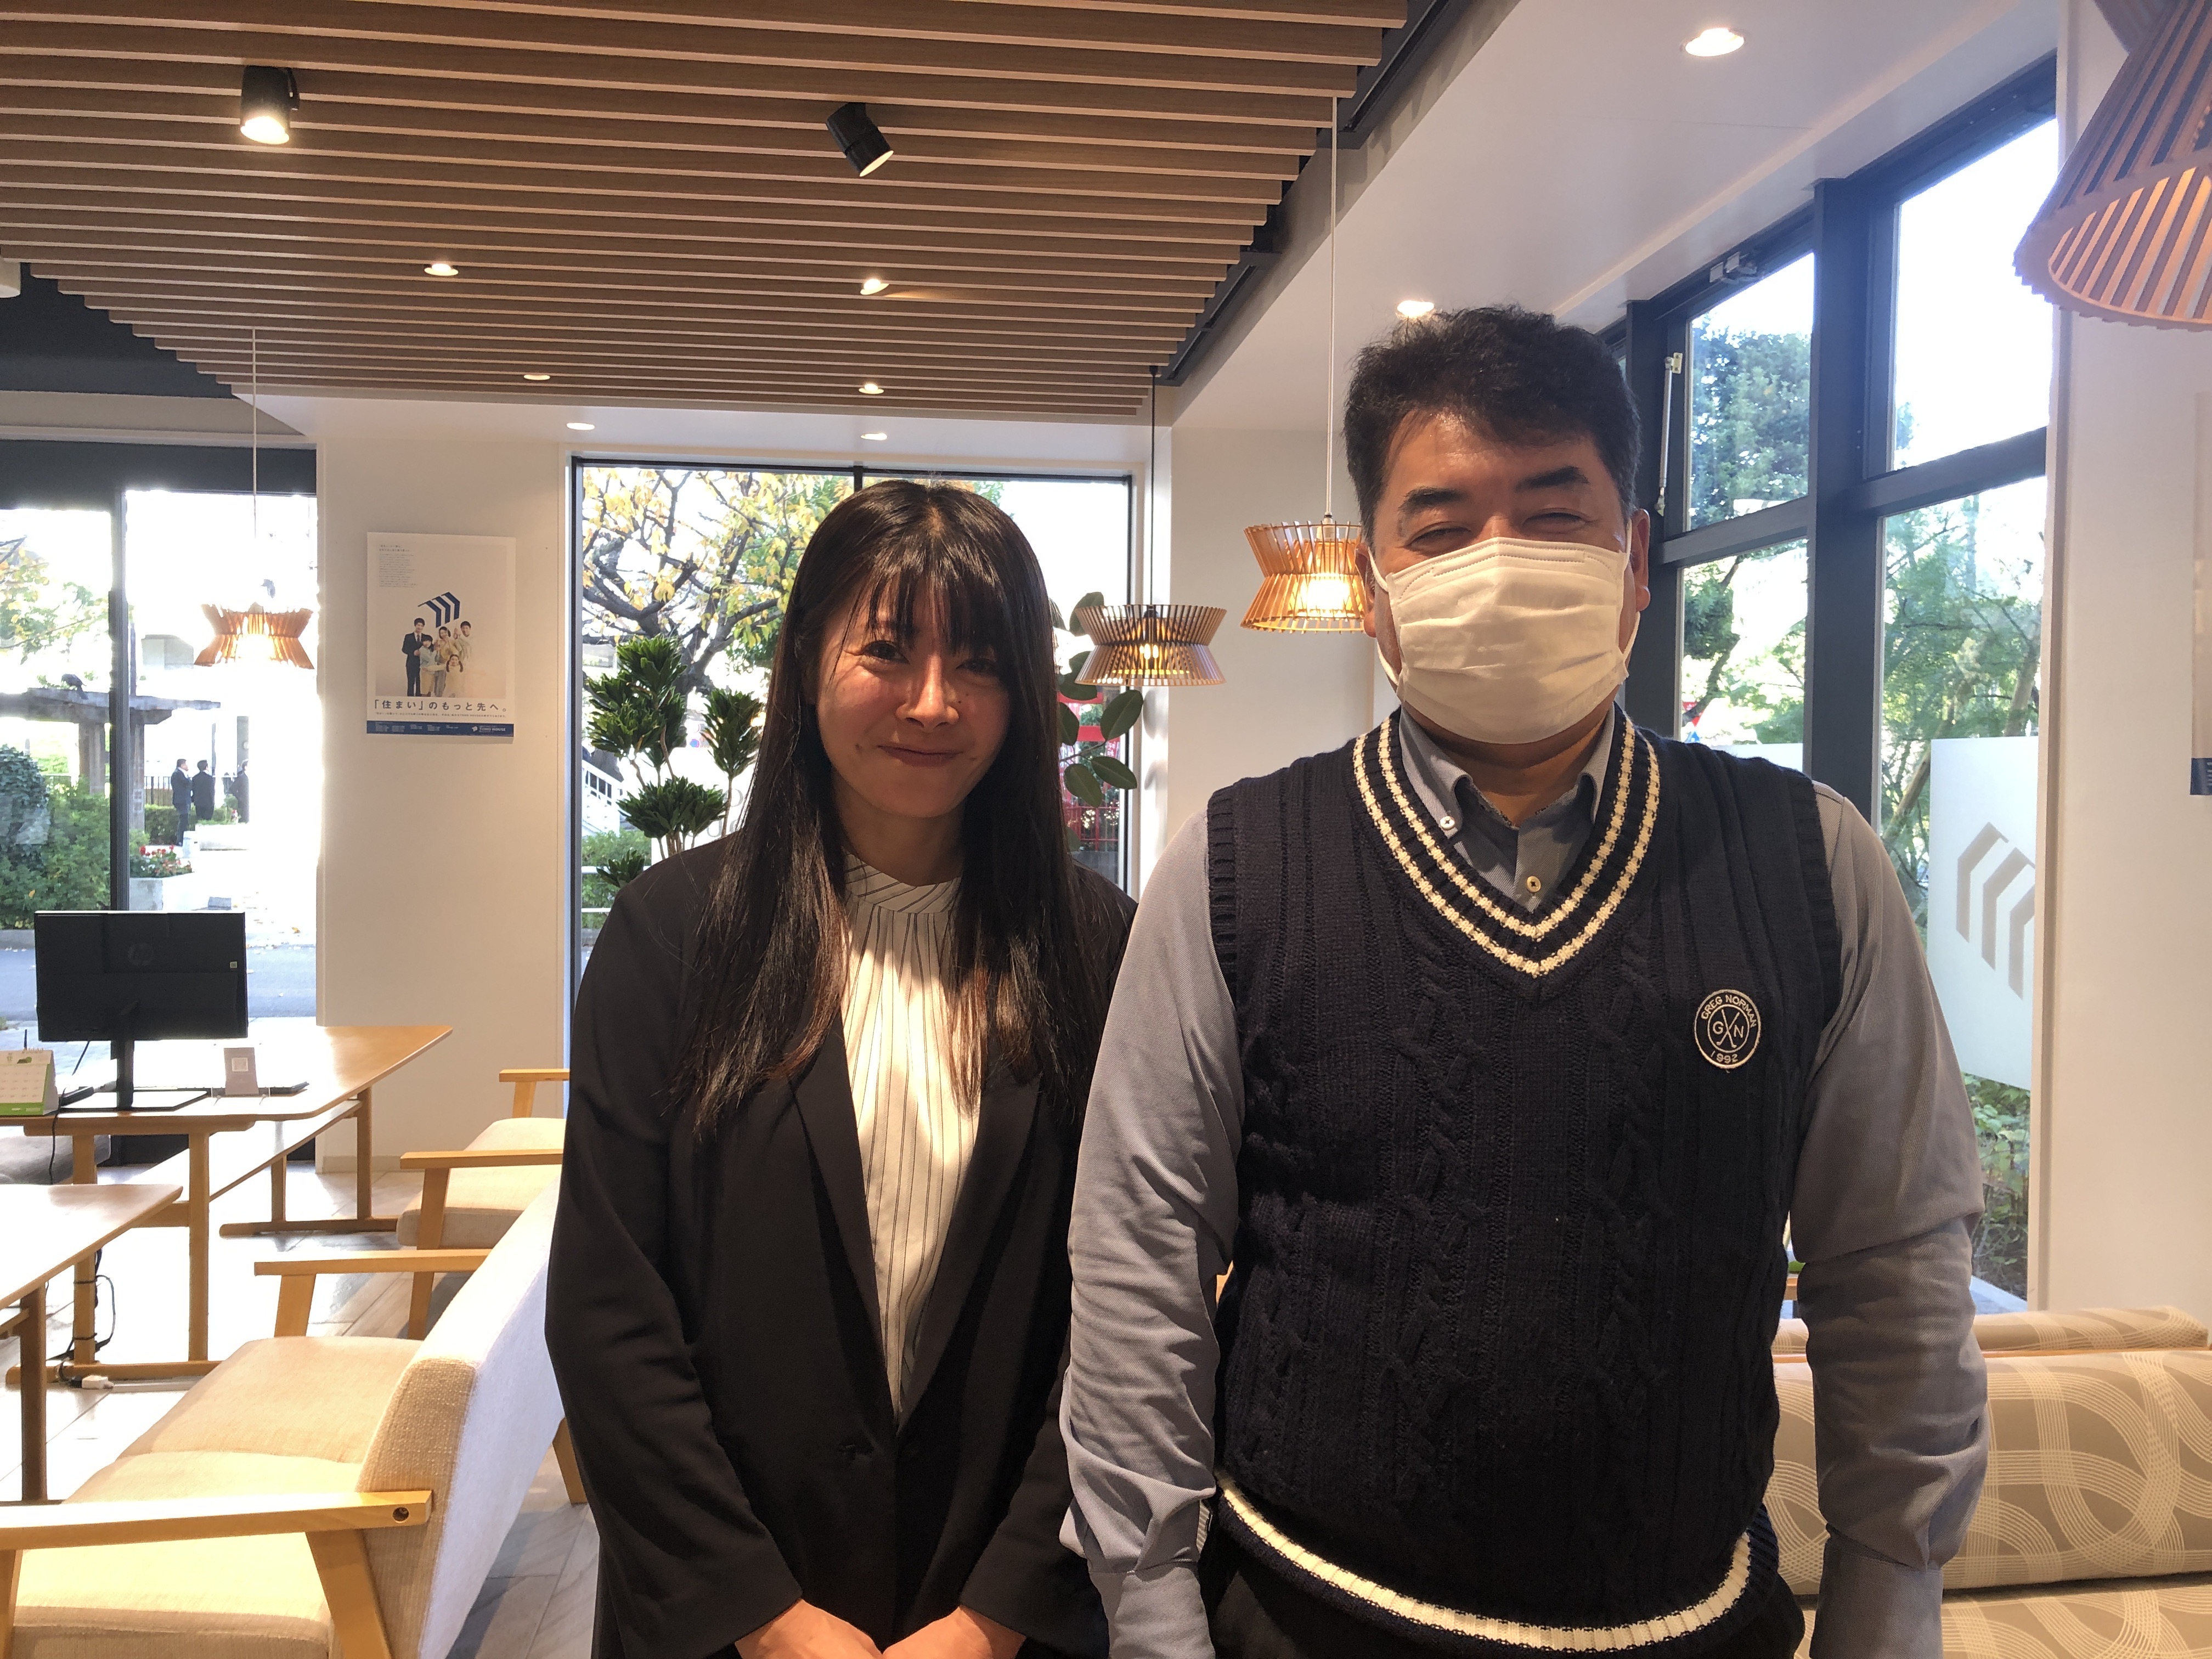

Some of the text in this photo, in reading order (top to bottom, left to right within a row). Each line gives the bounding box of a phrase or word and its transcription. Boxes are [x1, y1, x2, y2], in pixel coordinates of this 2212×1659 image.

[374, 699, 506, 712] 「住まい」のもっと先へ。
[1701, 994, 1757, 1028] GREG NORMAN
[1712, 1021, 1744, 1038] G N
[1711, 1050, 1739, 1064] 1992
